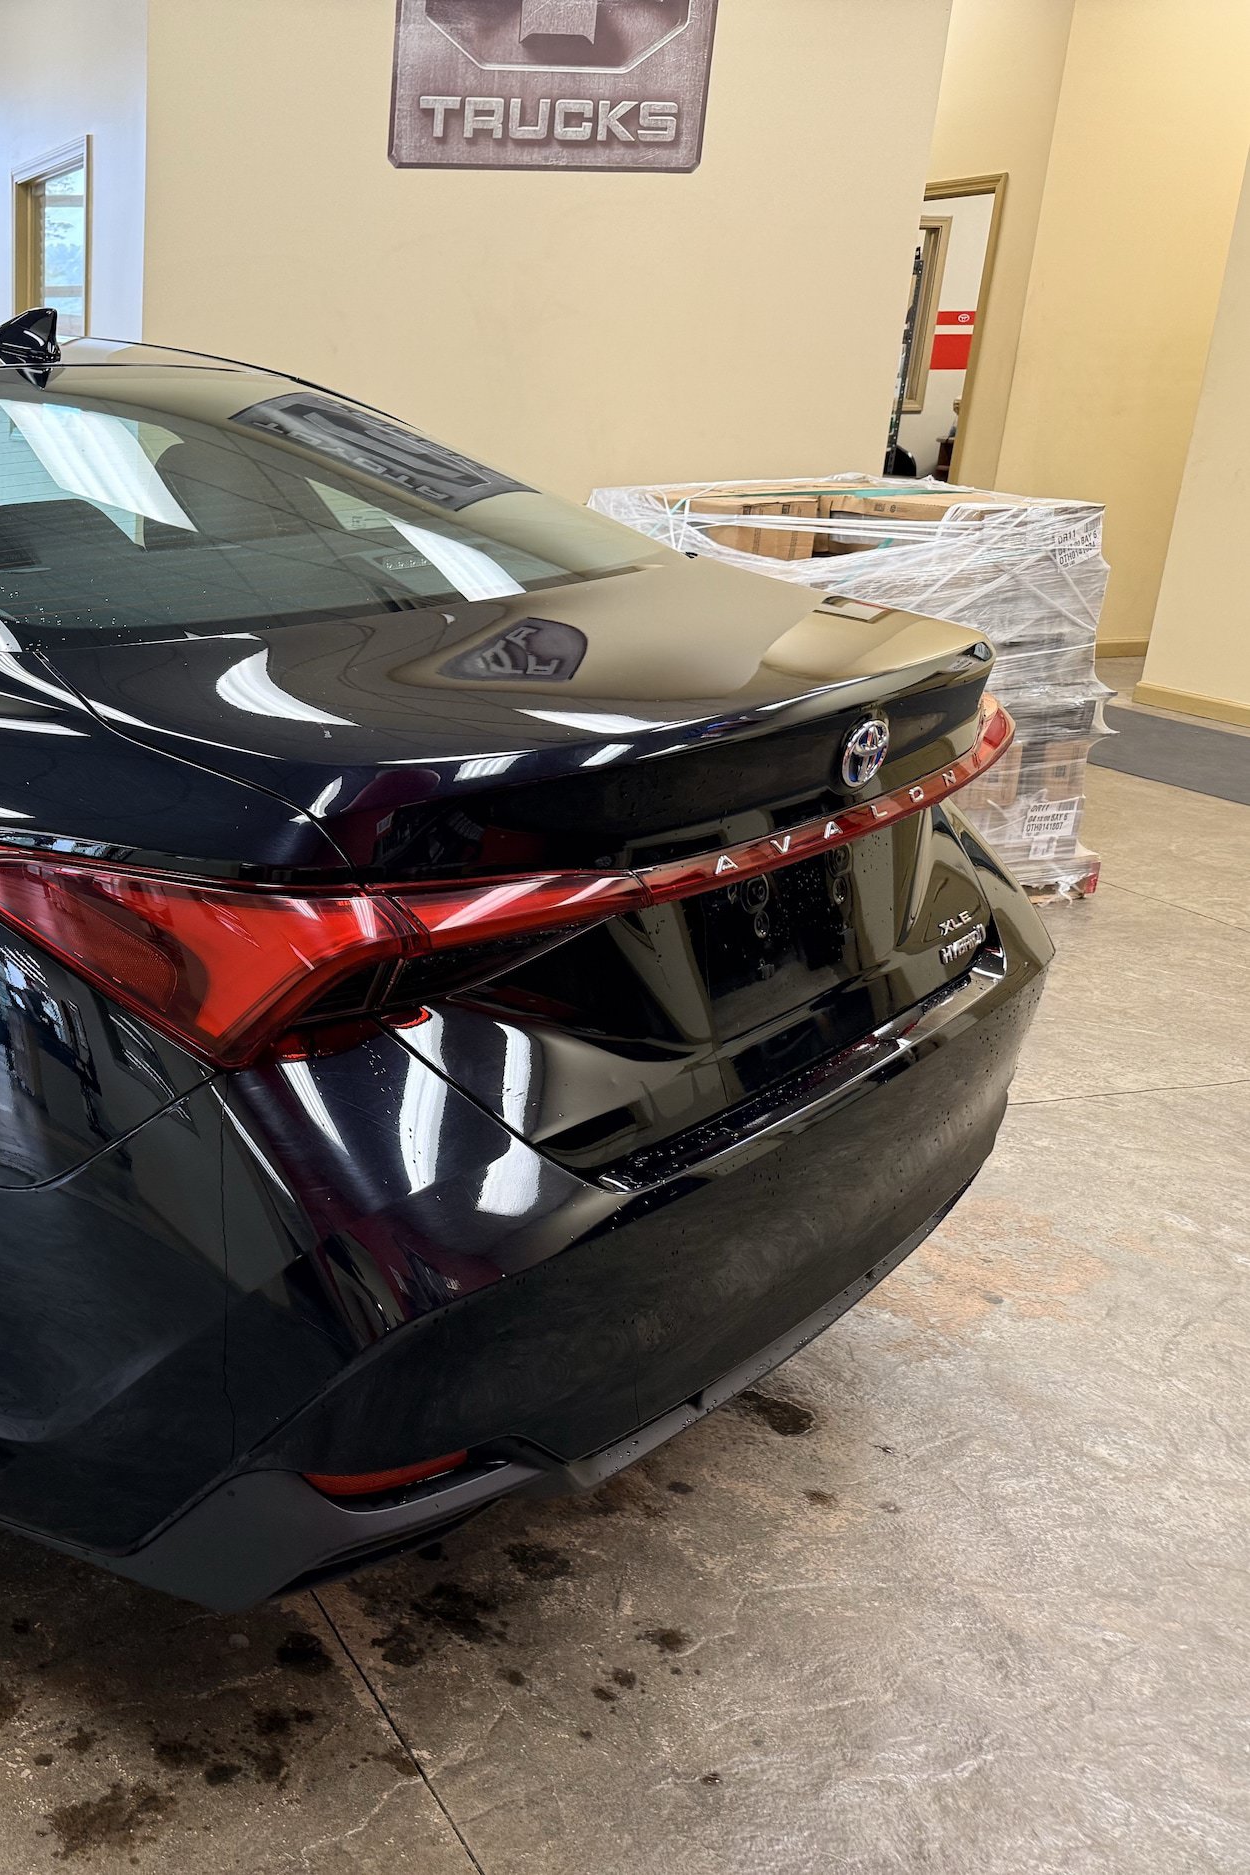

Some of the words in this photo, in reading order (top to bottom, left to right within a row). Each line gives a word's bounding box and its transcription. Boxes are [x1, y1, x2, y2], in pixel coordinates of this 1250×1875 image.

[419, 96, 678, 142] TRUCKS
[714, 769, 959, 876] AVALON
[939, 910, 972, 936] XLE
